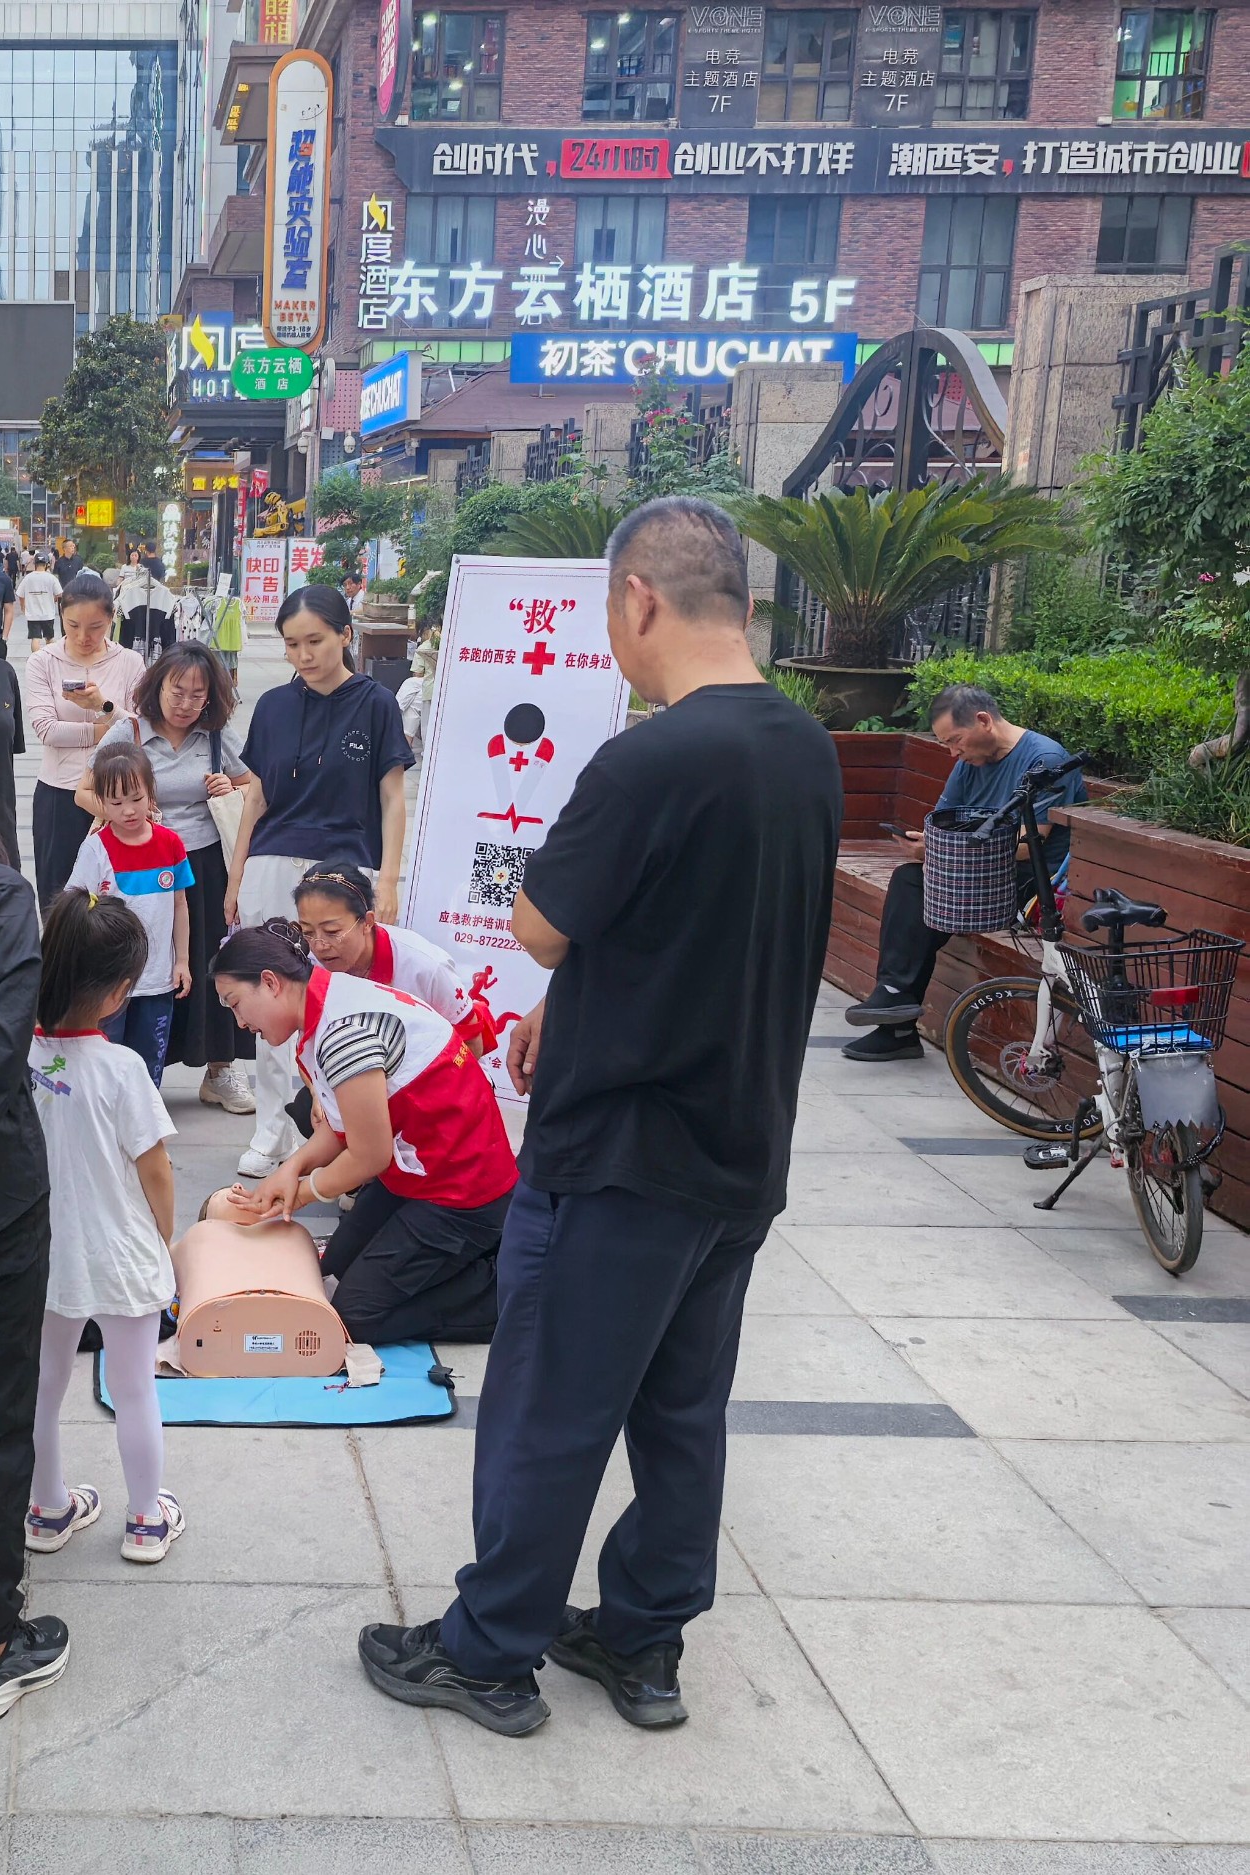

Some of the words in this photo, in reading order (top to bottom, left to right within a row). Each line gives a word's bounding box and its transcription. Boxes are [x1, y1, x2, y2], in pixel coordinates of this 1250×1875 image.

[705, 48, 741, 66] 电竞
[882, 47, 919, 66] 电竞
[684, 70, 759, 88] 主题酒店
[860, 70, 936, 88] 主题酒店
[708, 95, 732, 113] 7F
[884, 94, 909, 112] 7F
[281, 129, 316, 290] 超能实验室
[386, 260, 761, 322] 东方云栖酒店
[789, 279, 857, 325] 5F
[274, 299, 316, 311] MAKER
[279, 312, 309, 323] BETA
[241, 356, 303, 375] 东方云栖
[192, 379, 247, 400] HOT
[254, 377, 289, 391] 酒店
[246, 557, 279, 573] 快印
[245, 576, 278, 593] 广告
[244, 595, 279, 604] 办公用品
[459, 646, 517, 665] 奔跑的西安
[564, 652, 612, 670] 在你身边
[349, 742, 364, 750] FILA
[454, 931, 527, 952] 029-8722223
